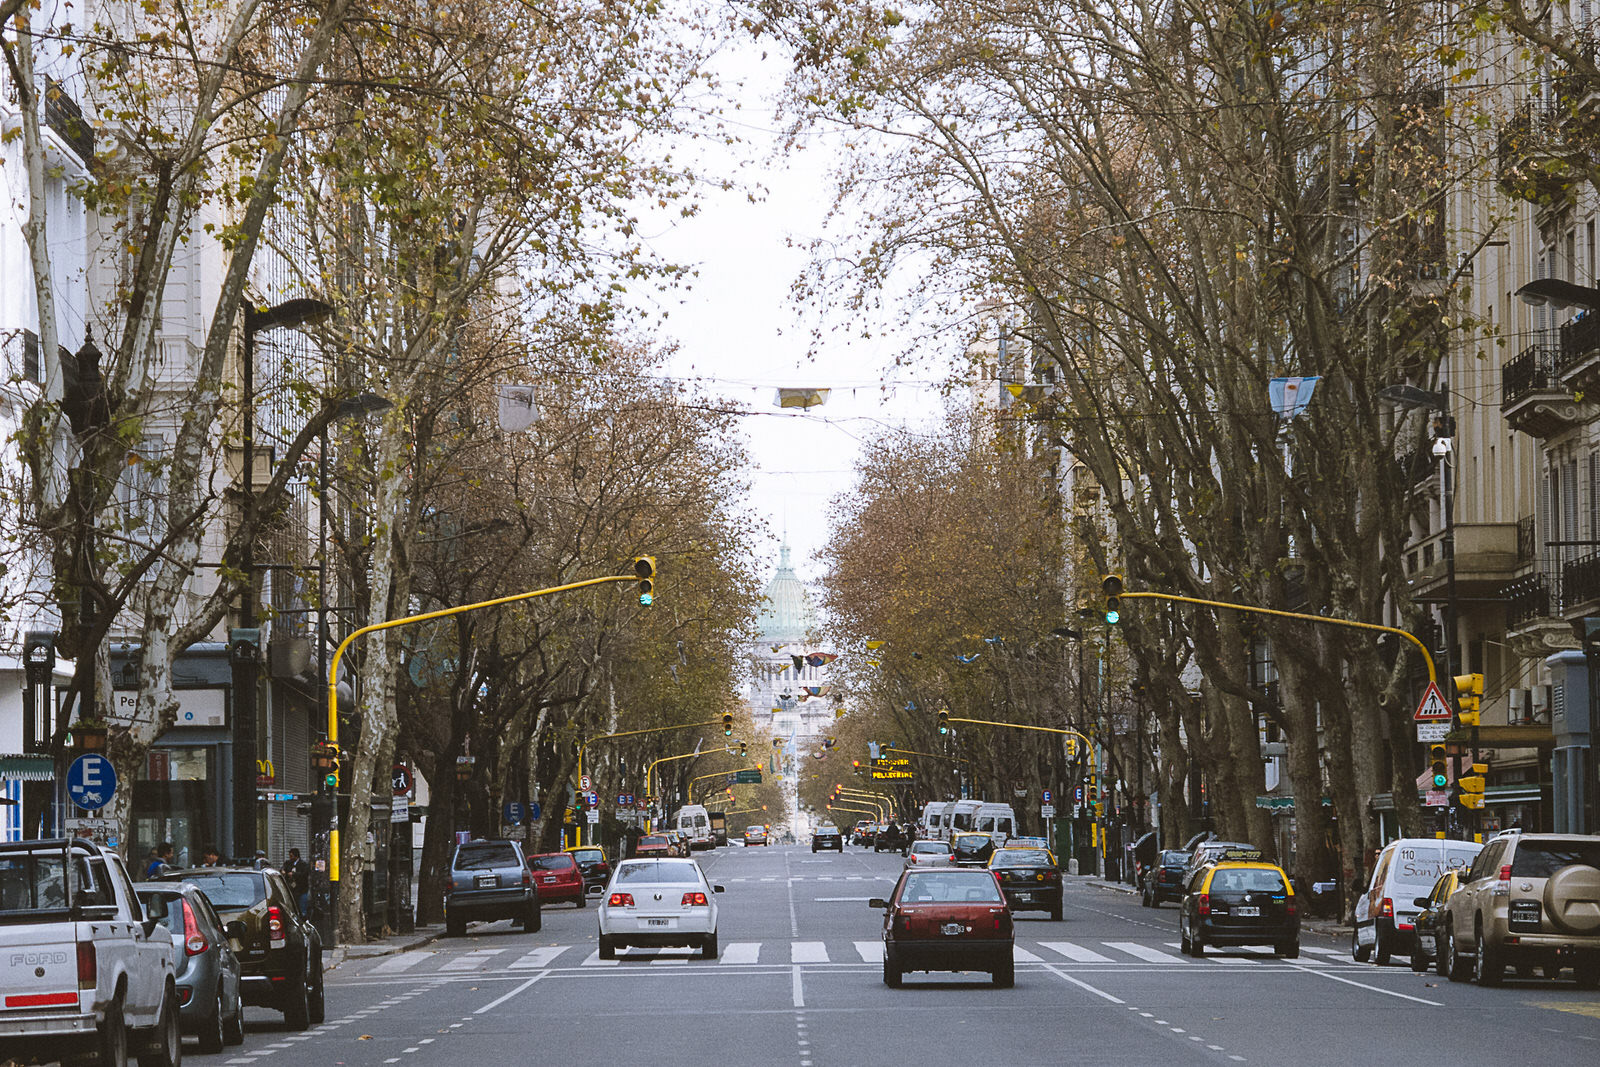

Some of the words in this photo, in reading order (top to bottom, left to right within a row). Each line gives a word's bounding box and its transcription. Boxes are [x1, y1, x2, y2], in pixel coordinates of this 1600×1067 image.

[83, 758, 102, 786] E
[872, 771, 913, 779] PELLEGRINI
[589, 793, 597, 805] E
[619, 795, 626, 805] E
[1044, 791, 1051, 801] E
[1076, 788, 1082, 800] E
[510, 802, 519, 814] E
[1402, 850, 1415, 860] 110
[1402, 862, 1432, 877] San
[10, 951, 68, 967] FORD
